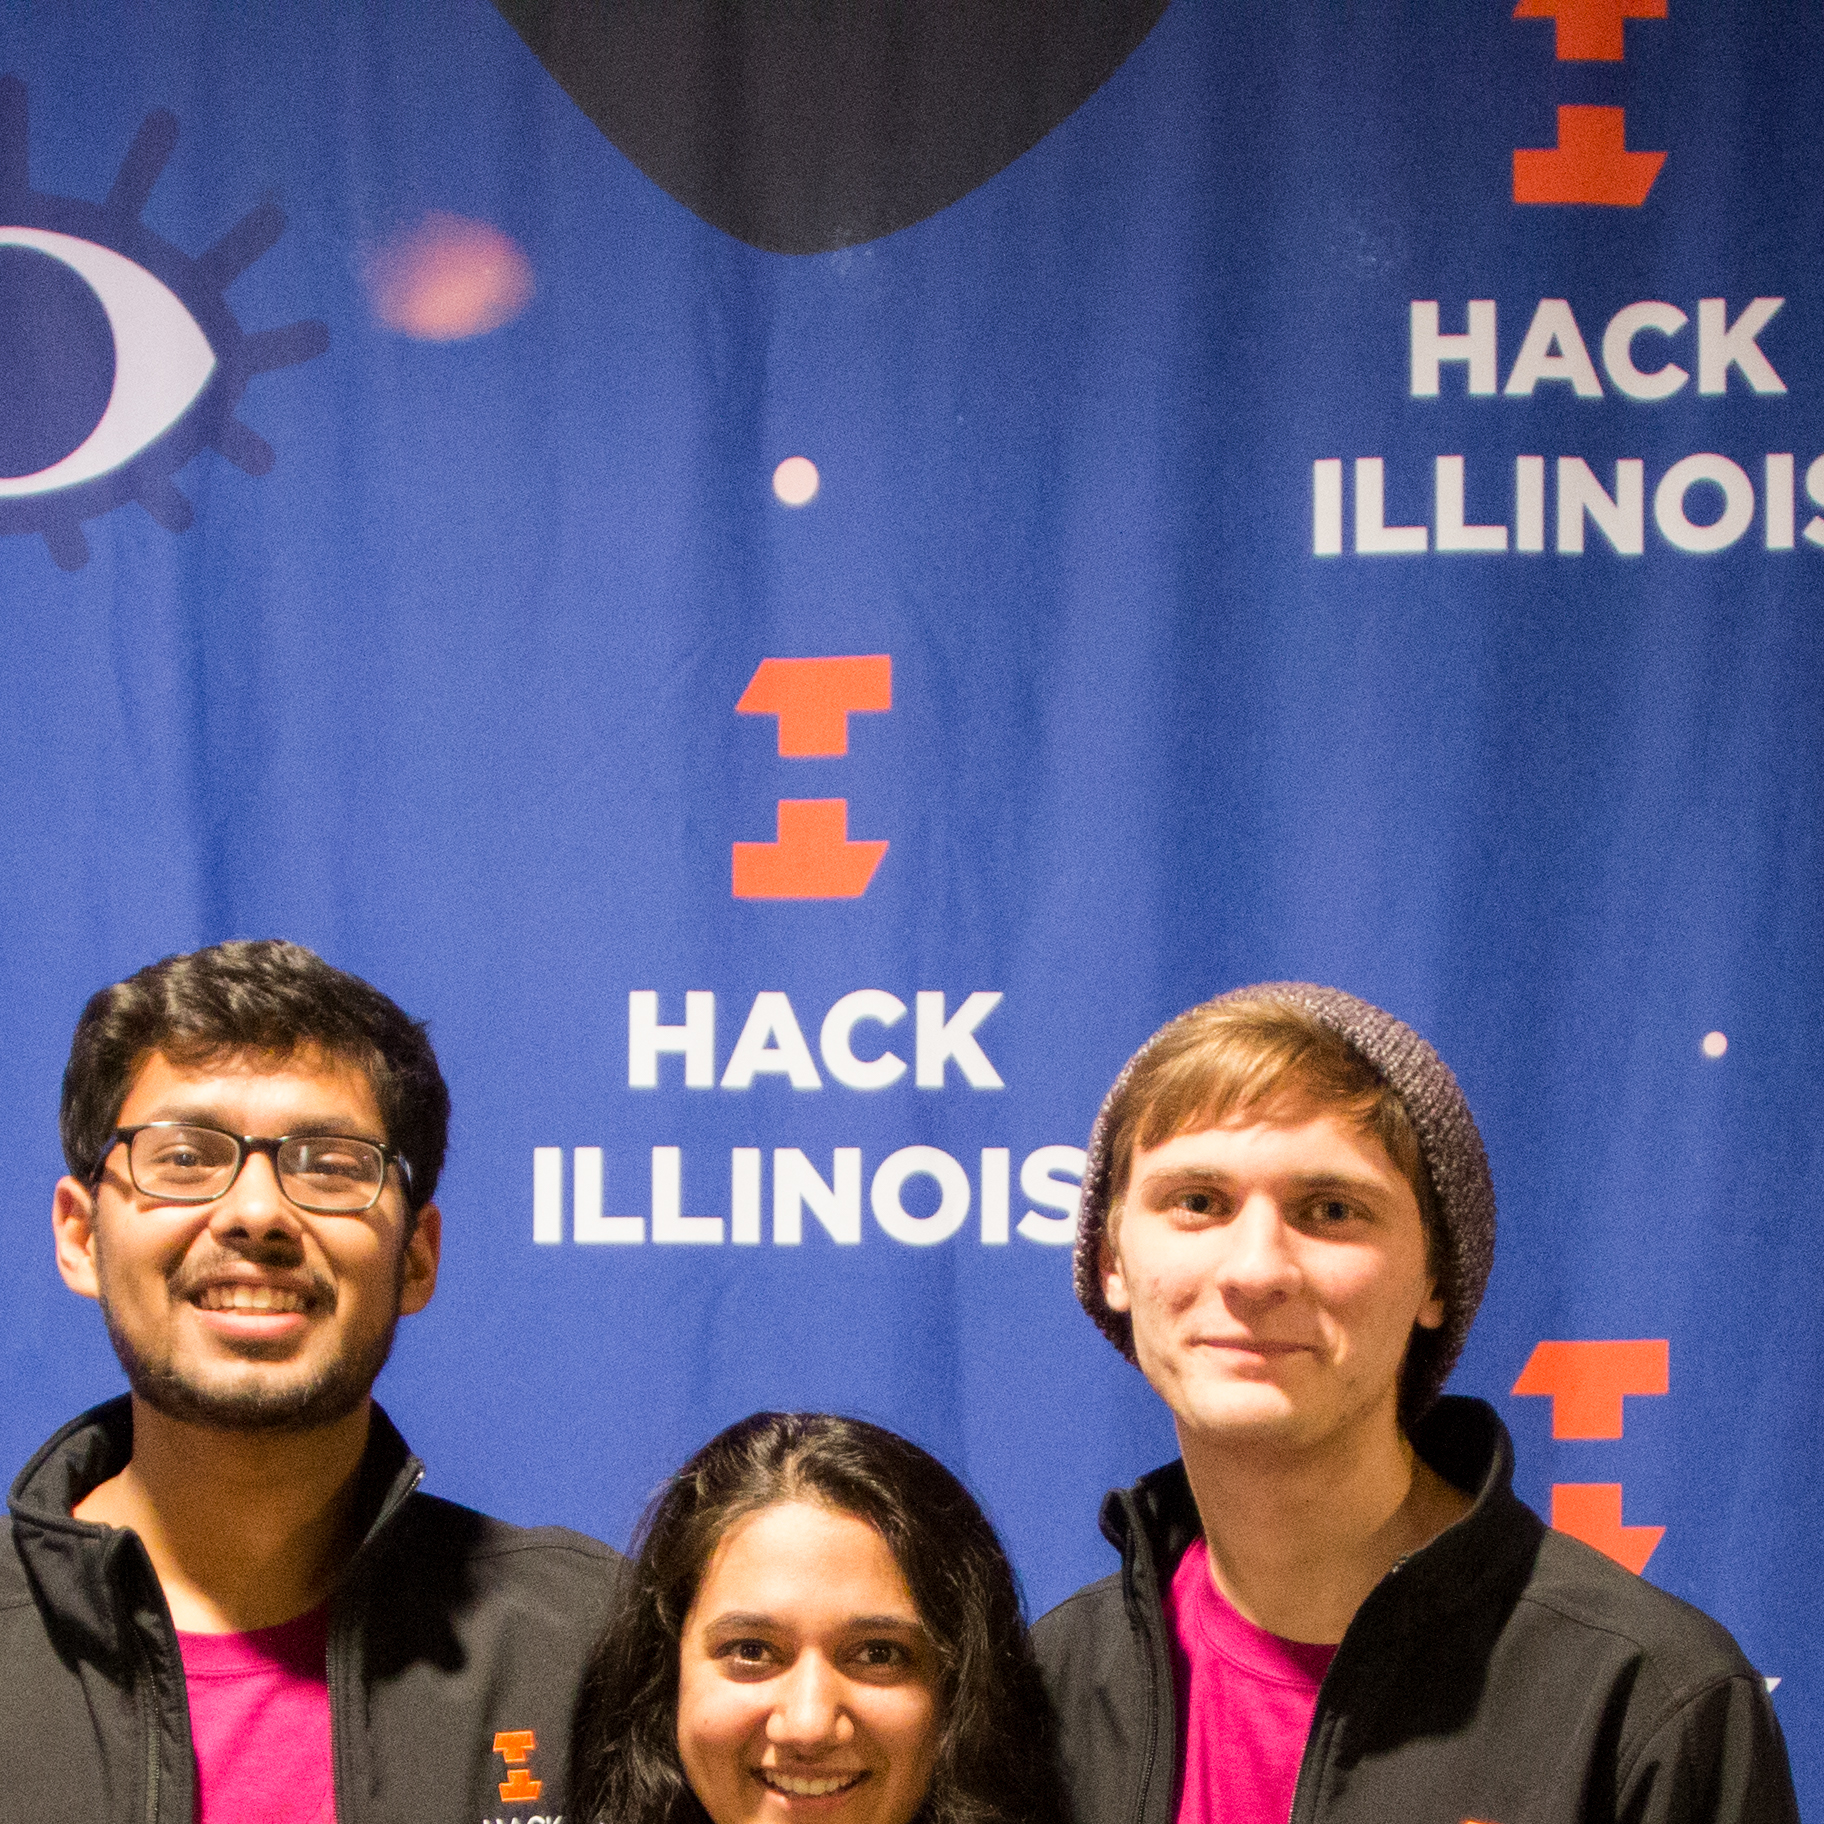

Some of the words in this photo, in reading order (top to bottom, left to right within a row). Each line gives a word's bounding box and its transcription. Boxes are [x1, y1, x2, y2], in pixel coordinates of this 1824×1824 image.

[1409, 297, 1788, 402] HACK
[627, 987, 1005, 1093] HACK
[532, 1143, 1087, 1247] ILLINOIS
